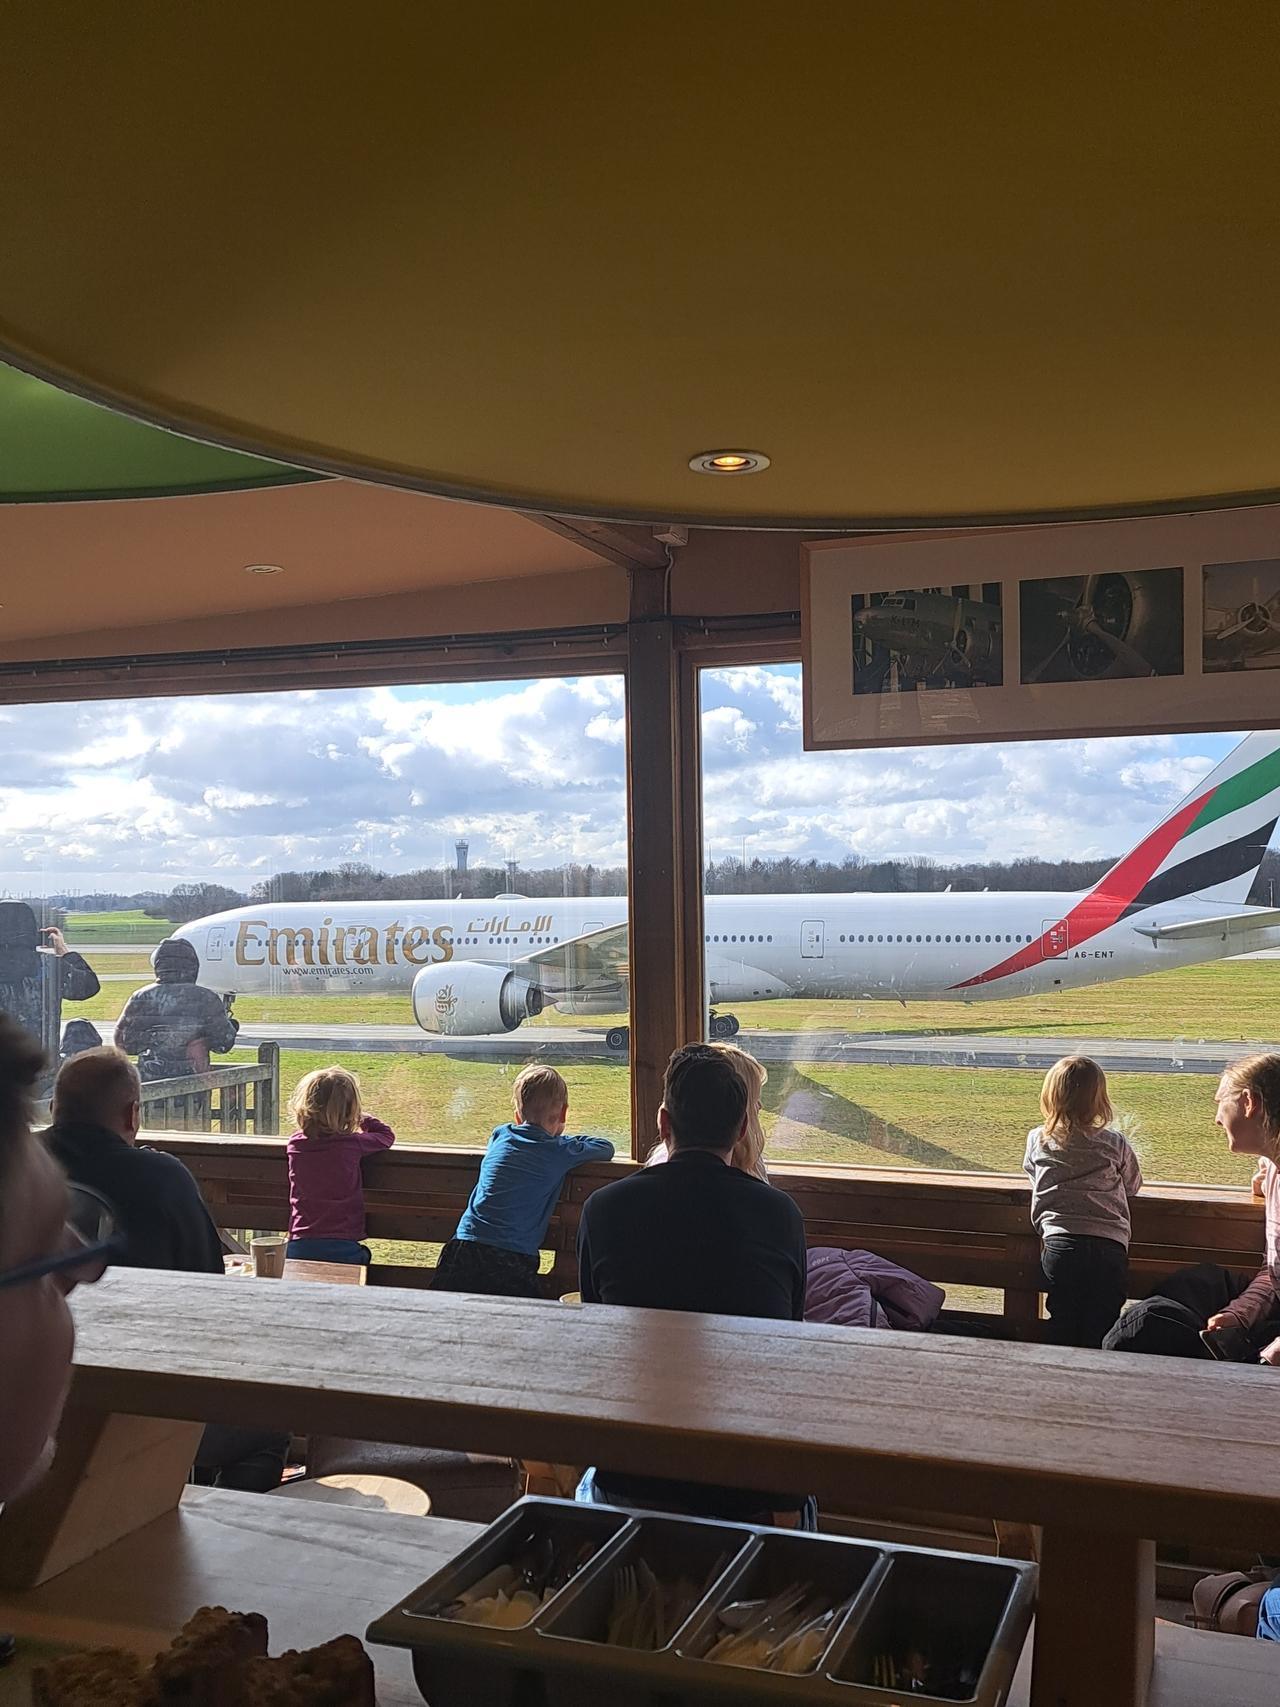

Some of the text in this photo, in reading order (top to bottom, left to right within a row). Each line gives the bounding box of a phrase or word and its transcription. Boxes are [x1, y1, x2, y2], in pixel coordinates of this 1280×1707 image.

[466, 915, 553, 936] الإمارات
[235, 917, 455, 966] Emirates
[1074, 950, 1115, 959] A6-ENT
[282, 966, 374, 976] www.emirates.com
